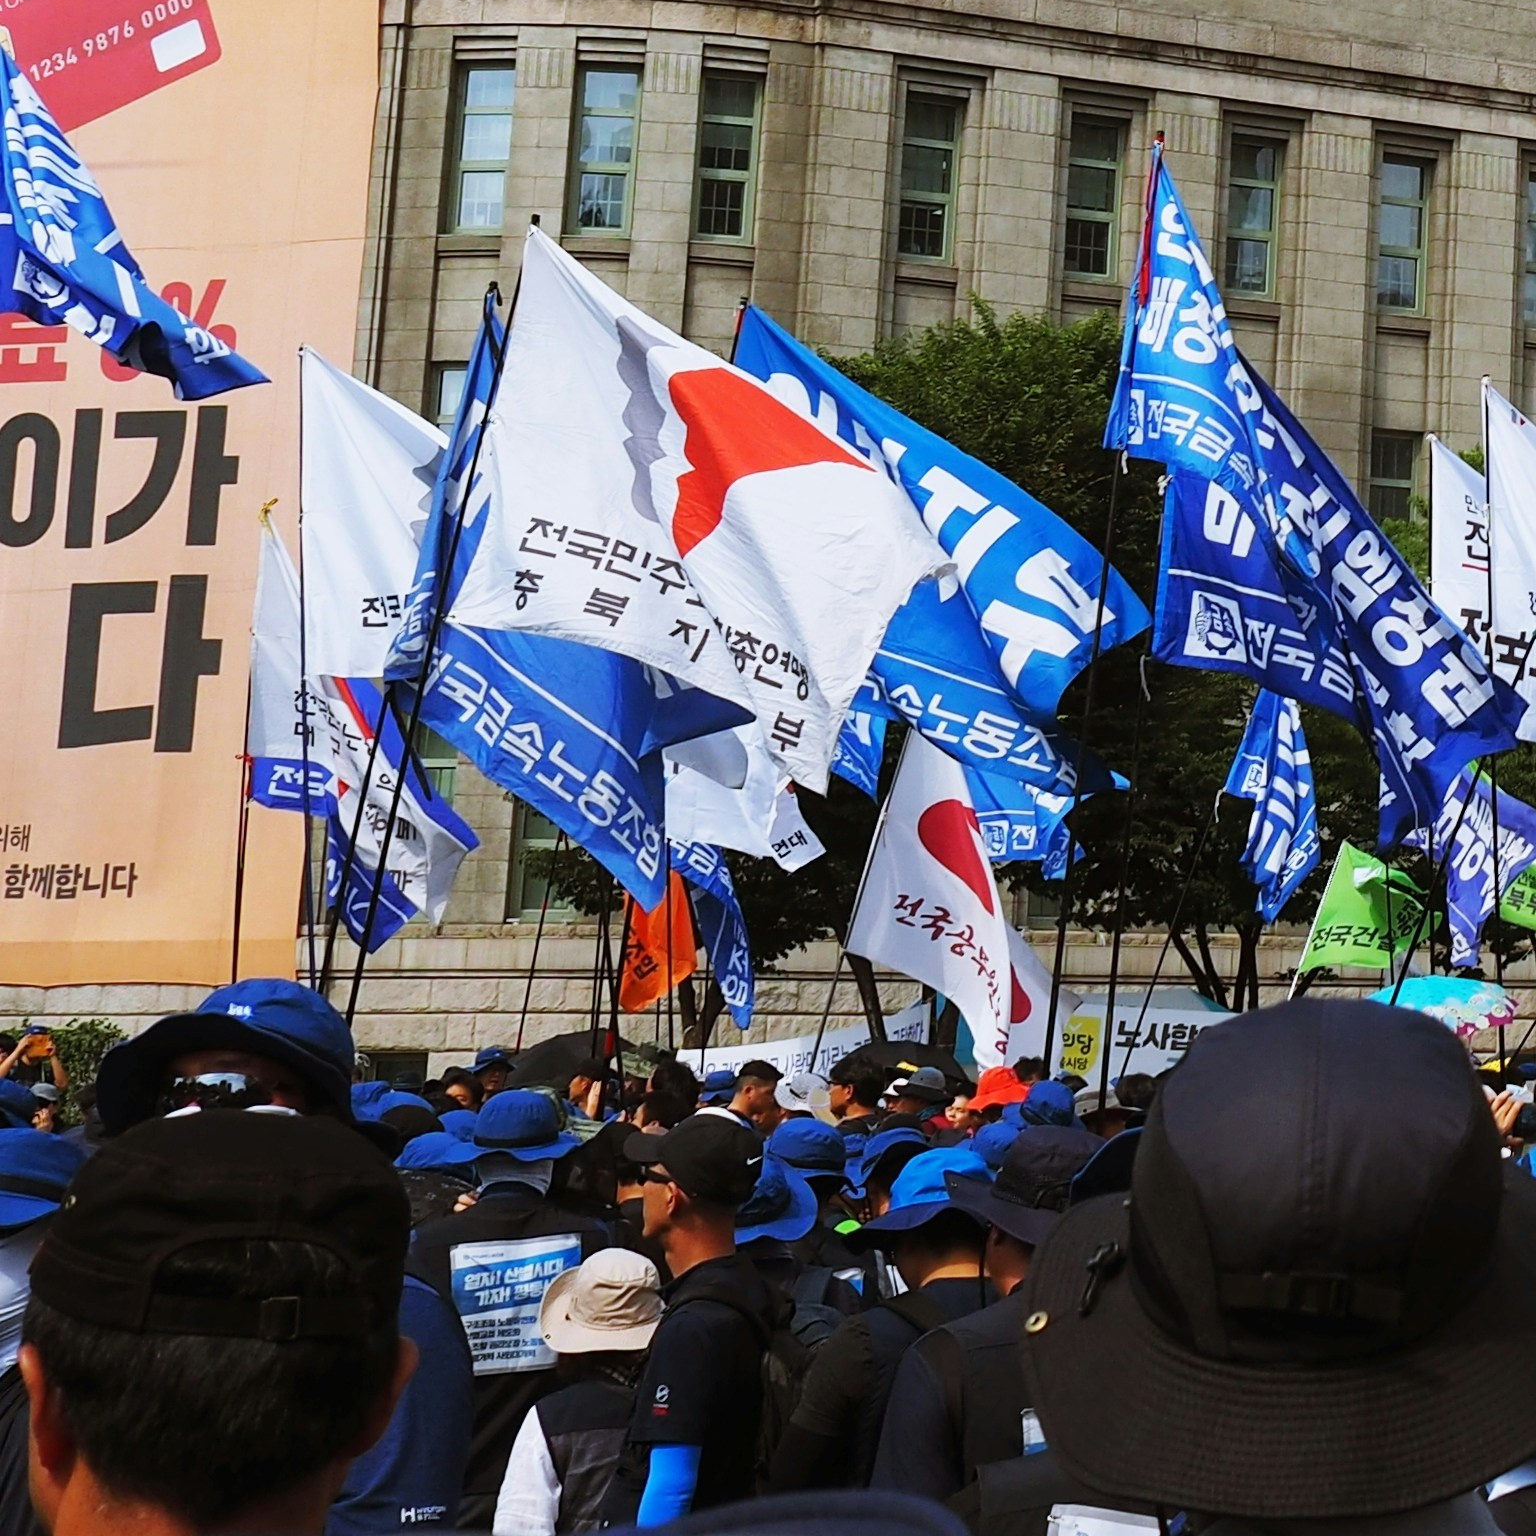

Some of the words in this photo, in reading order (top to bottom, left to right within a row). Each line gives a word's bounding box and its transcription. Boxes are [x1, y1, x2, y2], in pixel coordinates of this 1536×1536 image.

[29, 49, 79, 84] 1234
[82, 20, 136, 59] 9876
[57, 574, 222, 753] 다
[4, 861, 139, 903] 함께합니다
